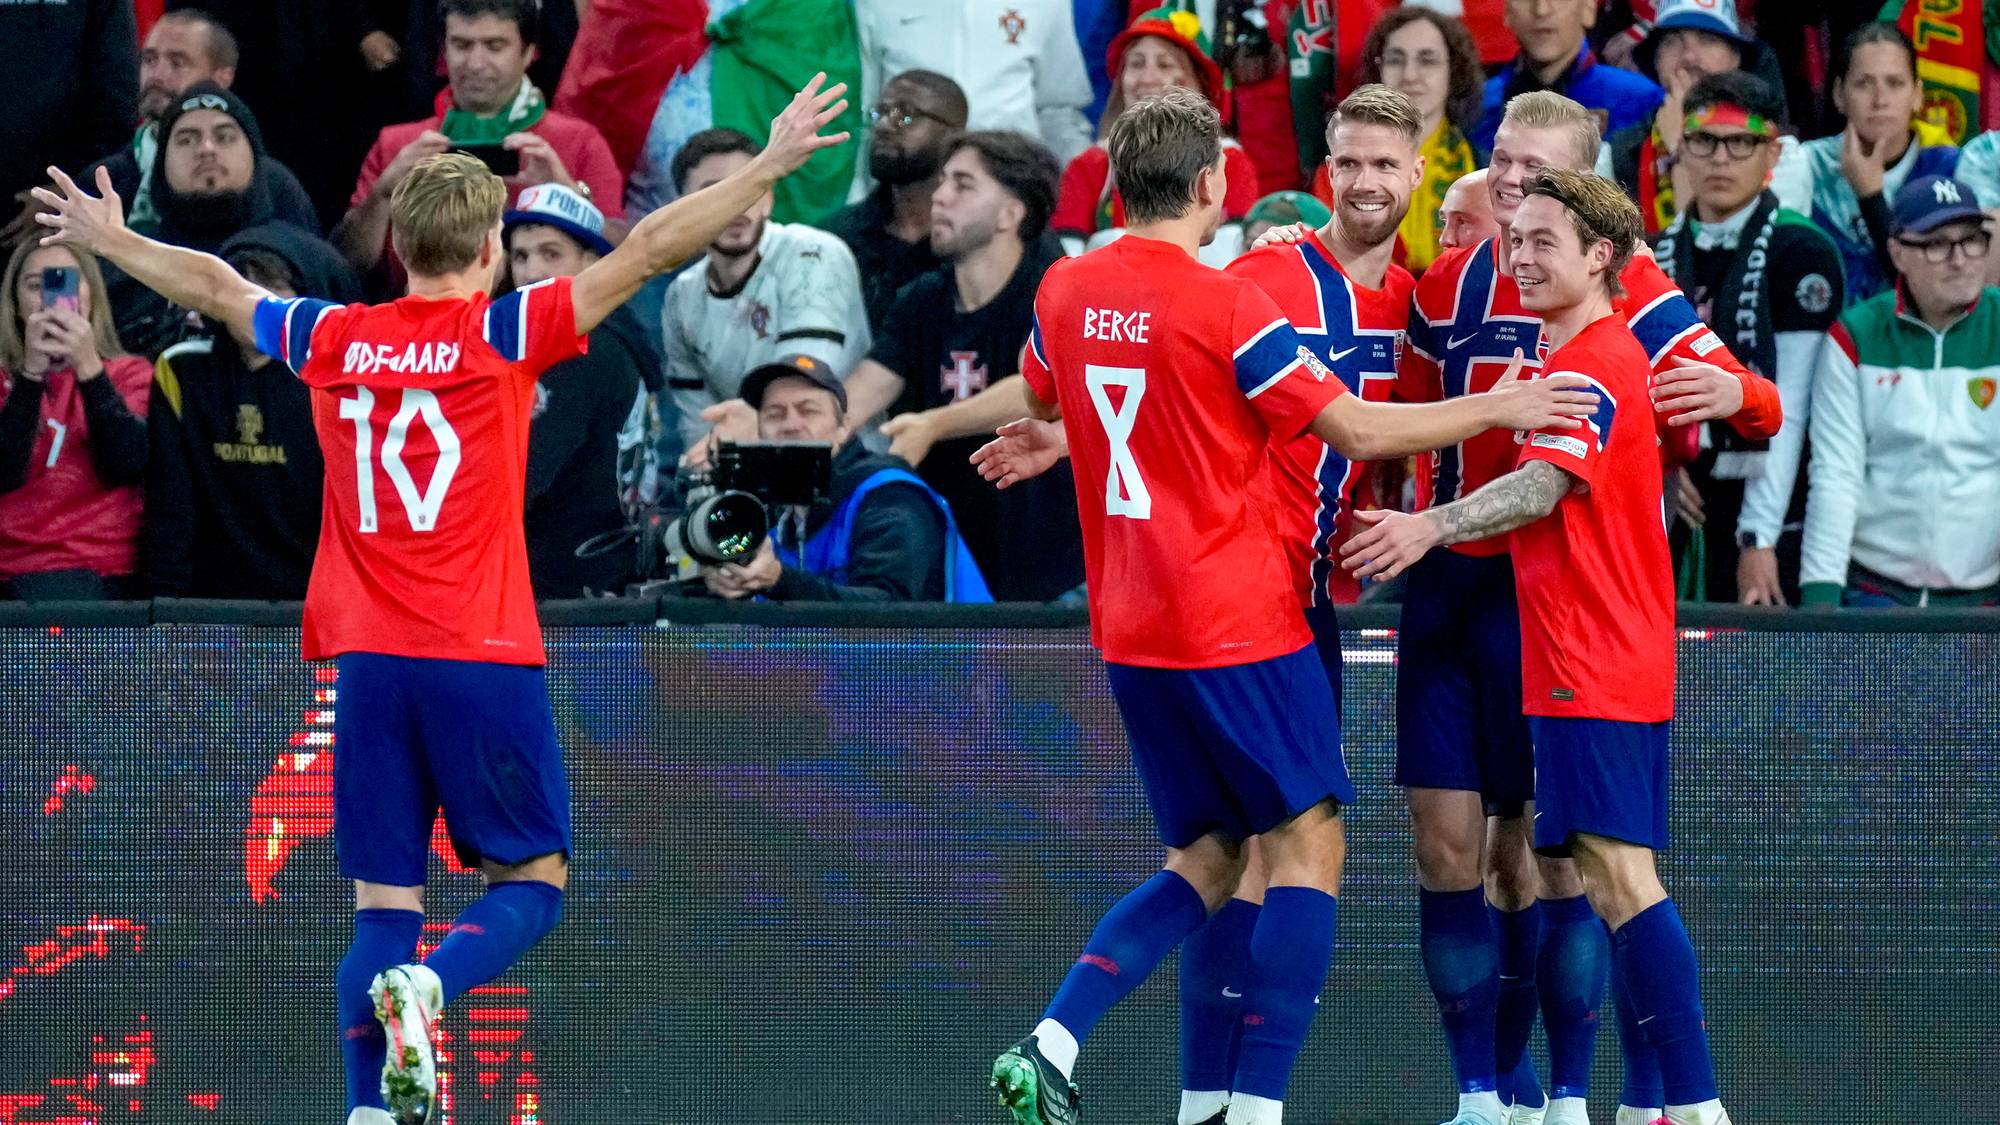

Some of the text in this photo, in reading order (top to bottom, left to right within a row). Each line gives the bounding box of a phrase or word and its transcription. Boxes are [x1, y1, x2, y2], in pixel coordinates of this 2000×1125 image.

[1931, 179, 1962, 204] NY
[1083, 306, 1151, 343] BERGE
[46, 417, 66, 468] 7
[339, 384, 462, 533] 10
[1085, 363, 1151, 520] 8
